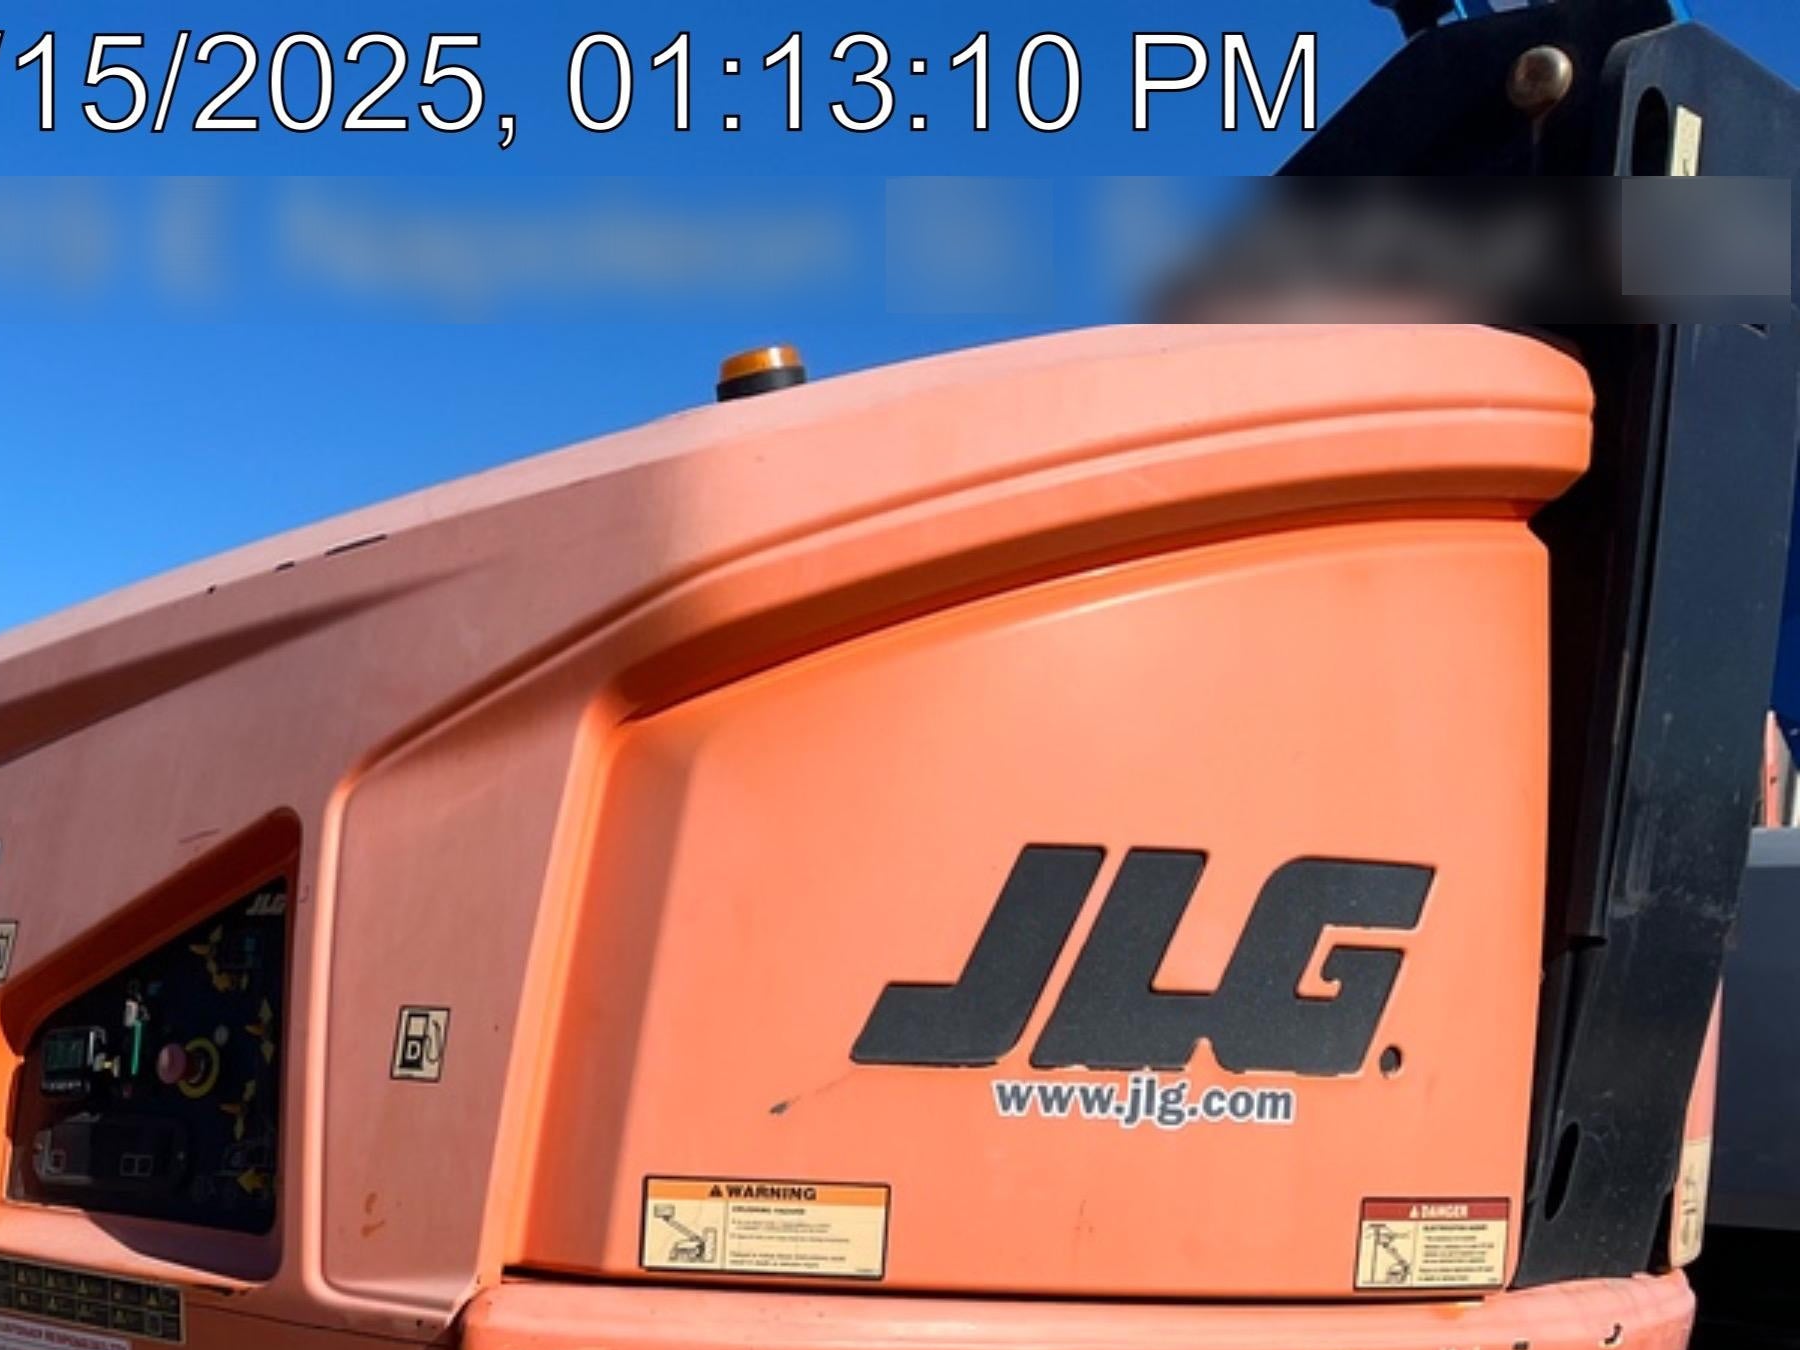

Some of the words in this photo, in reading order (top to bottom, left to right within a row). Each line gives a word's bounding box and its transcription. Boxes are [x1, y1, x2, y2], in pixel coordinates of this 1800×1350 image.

[849, 843, 1436, 1076] JLG
[995, 1076, 1294, 1126] www.jlg.com
[726, 1184, 816, 1200] WARNING
